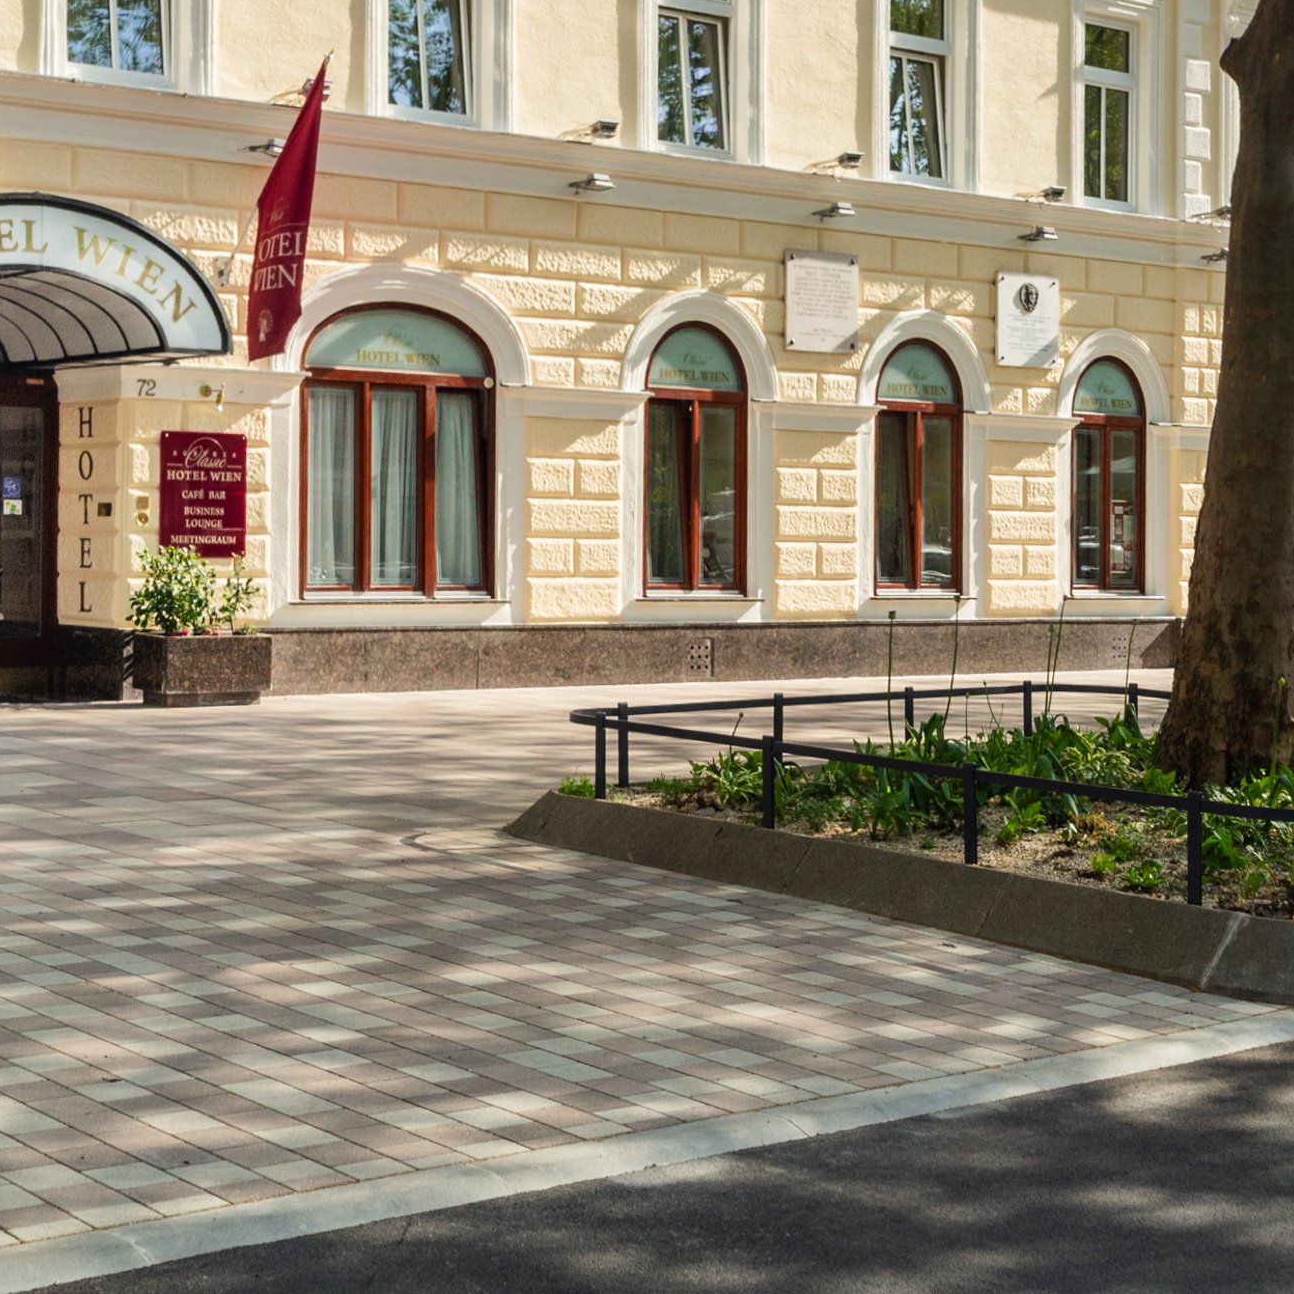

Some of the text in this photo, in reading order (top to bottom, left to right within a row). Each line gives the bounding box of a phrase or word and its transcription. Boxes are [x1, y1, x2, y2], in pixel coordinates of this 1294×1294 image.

[258, 232, 304, 262] OTEL
[73, 225, 198, 324] WIEN
[355, 349, 440, 366] HOTEL WIEN
[659, 369, 730, 383] HOTEL WIEN
[137, 378, 157, 396] 72
[887, 383, 947, 396] HOTEL WIEN
[185, 445, 227, 468] Classic
[167, 470, 242, 482] HOTEL WIEN
[182, 488, 226, 500] CAFÉ BAR
[78, 406, 94, 613] HOTEL
[184, 506, 225, 516] BUSINESS
[185, 519, 223, 528] LOUNGE
[170, 535, 236, 544] MEETINGRAUM
